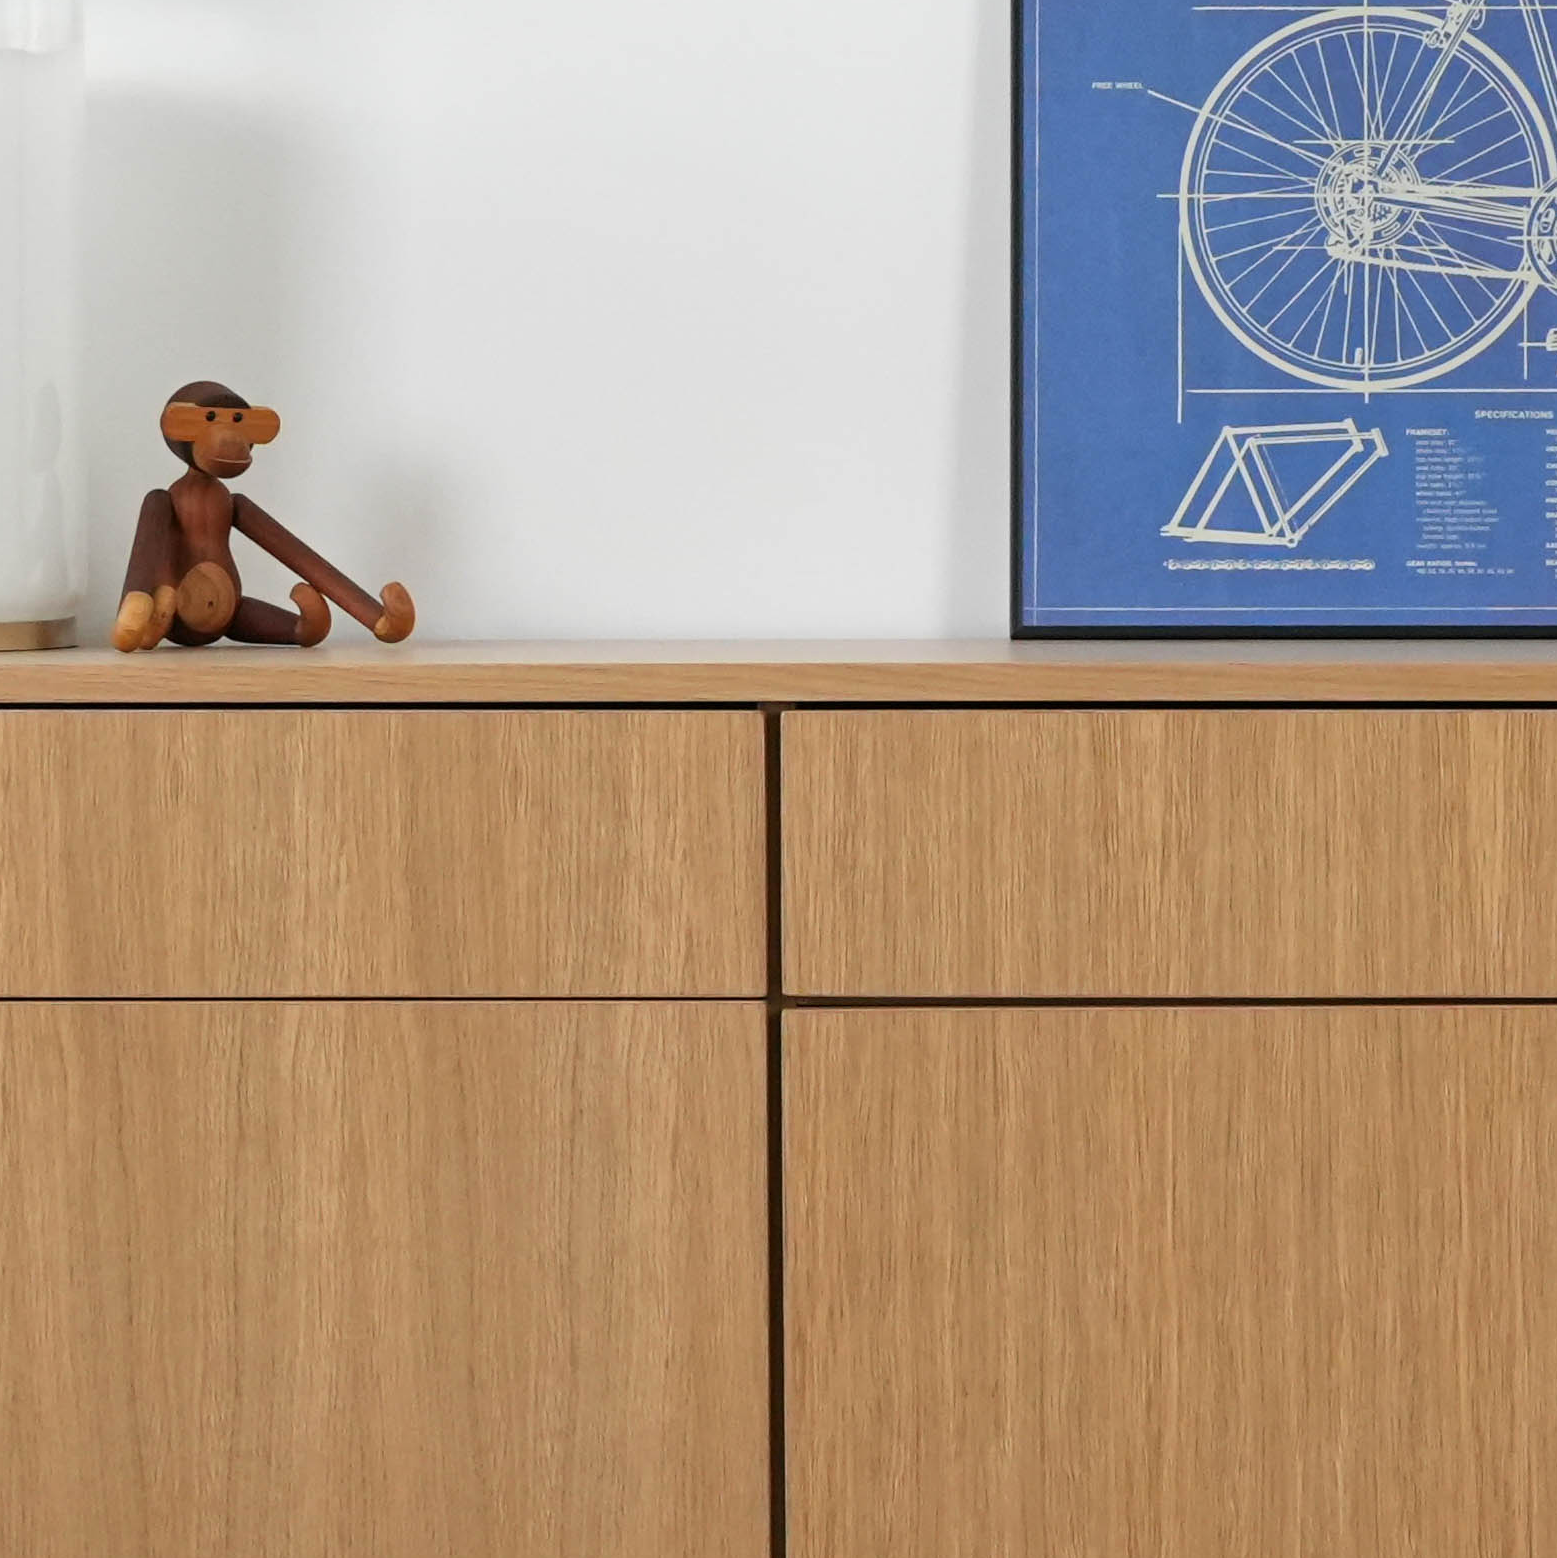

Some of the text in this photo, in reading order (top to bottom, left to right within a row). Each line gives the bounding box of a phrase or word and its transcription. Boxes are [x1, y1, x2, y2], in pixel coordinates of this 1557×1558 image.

[1092, 82, 1143, 90] FREE WHEEL
[1474, 410, 1554, 419] SPECIFICATIONS
